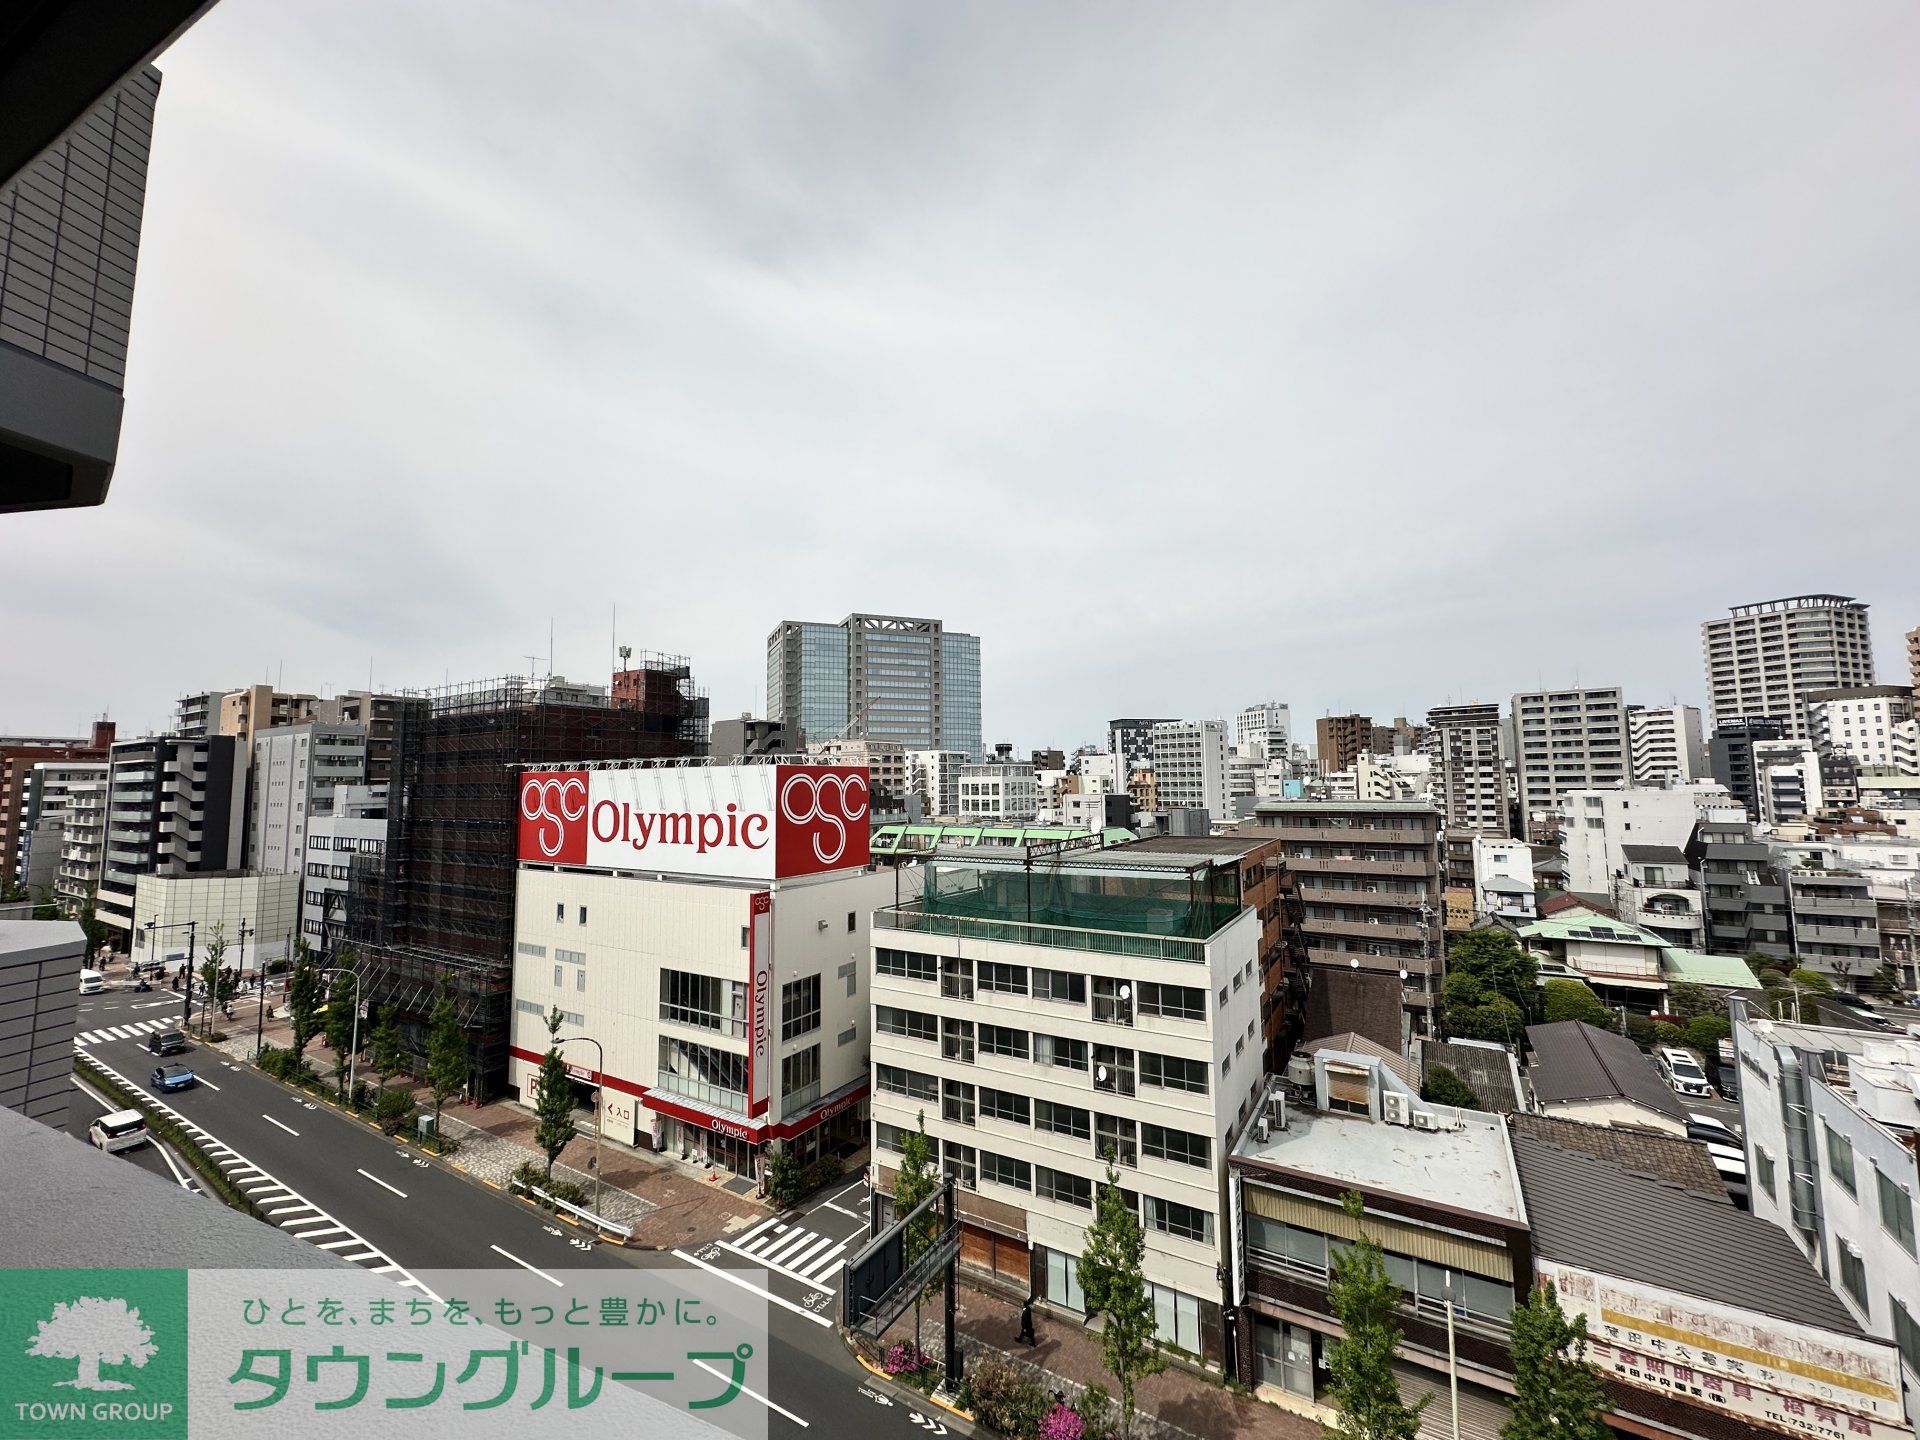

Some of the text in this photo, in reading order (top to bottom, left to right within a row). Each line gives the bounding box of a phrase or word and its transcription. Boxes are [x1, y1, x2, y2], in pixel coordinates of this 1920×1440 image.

[591, 798, 770, 854] Olympic
[755, 970, 768, 1057] Olympic
[616, 1107, 630, 1121] 入口
[820, 1097, 853, 1120] Olympic
[711, 1119, 748, 1139] Olympic
